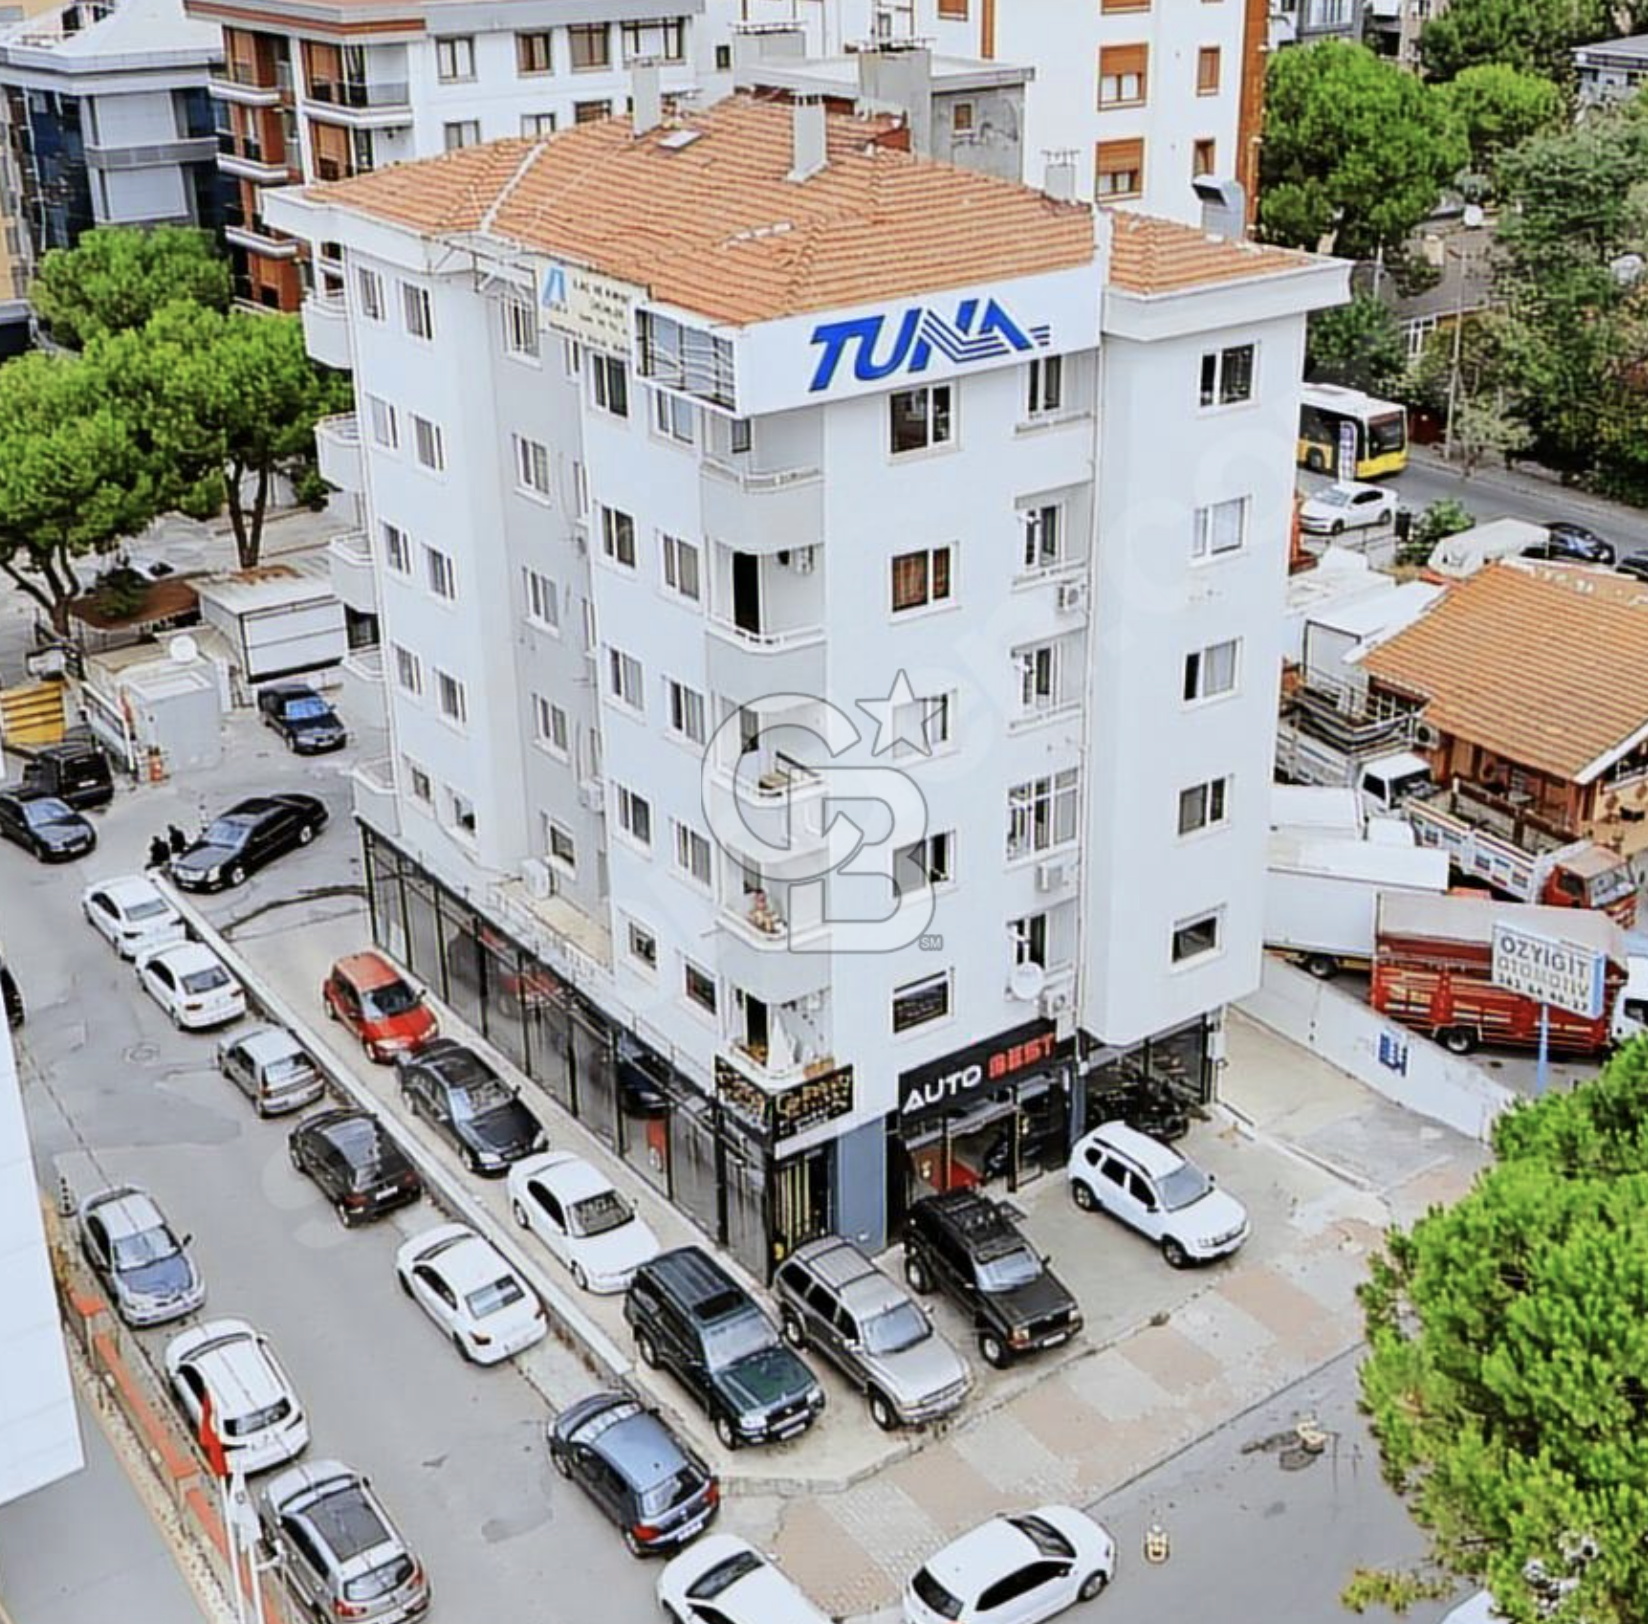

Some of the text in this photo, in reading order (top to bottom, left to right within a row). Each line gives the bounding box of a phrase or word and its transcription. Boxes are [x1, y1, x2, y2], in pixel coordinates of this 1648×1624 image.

[808, 298, 1050, 392] TUNA
[902, 1064, 982, 1115] AUTO
[988, 1032, 1055, 1080] BEST
